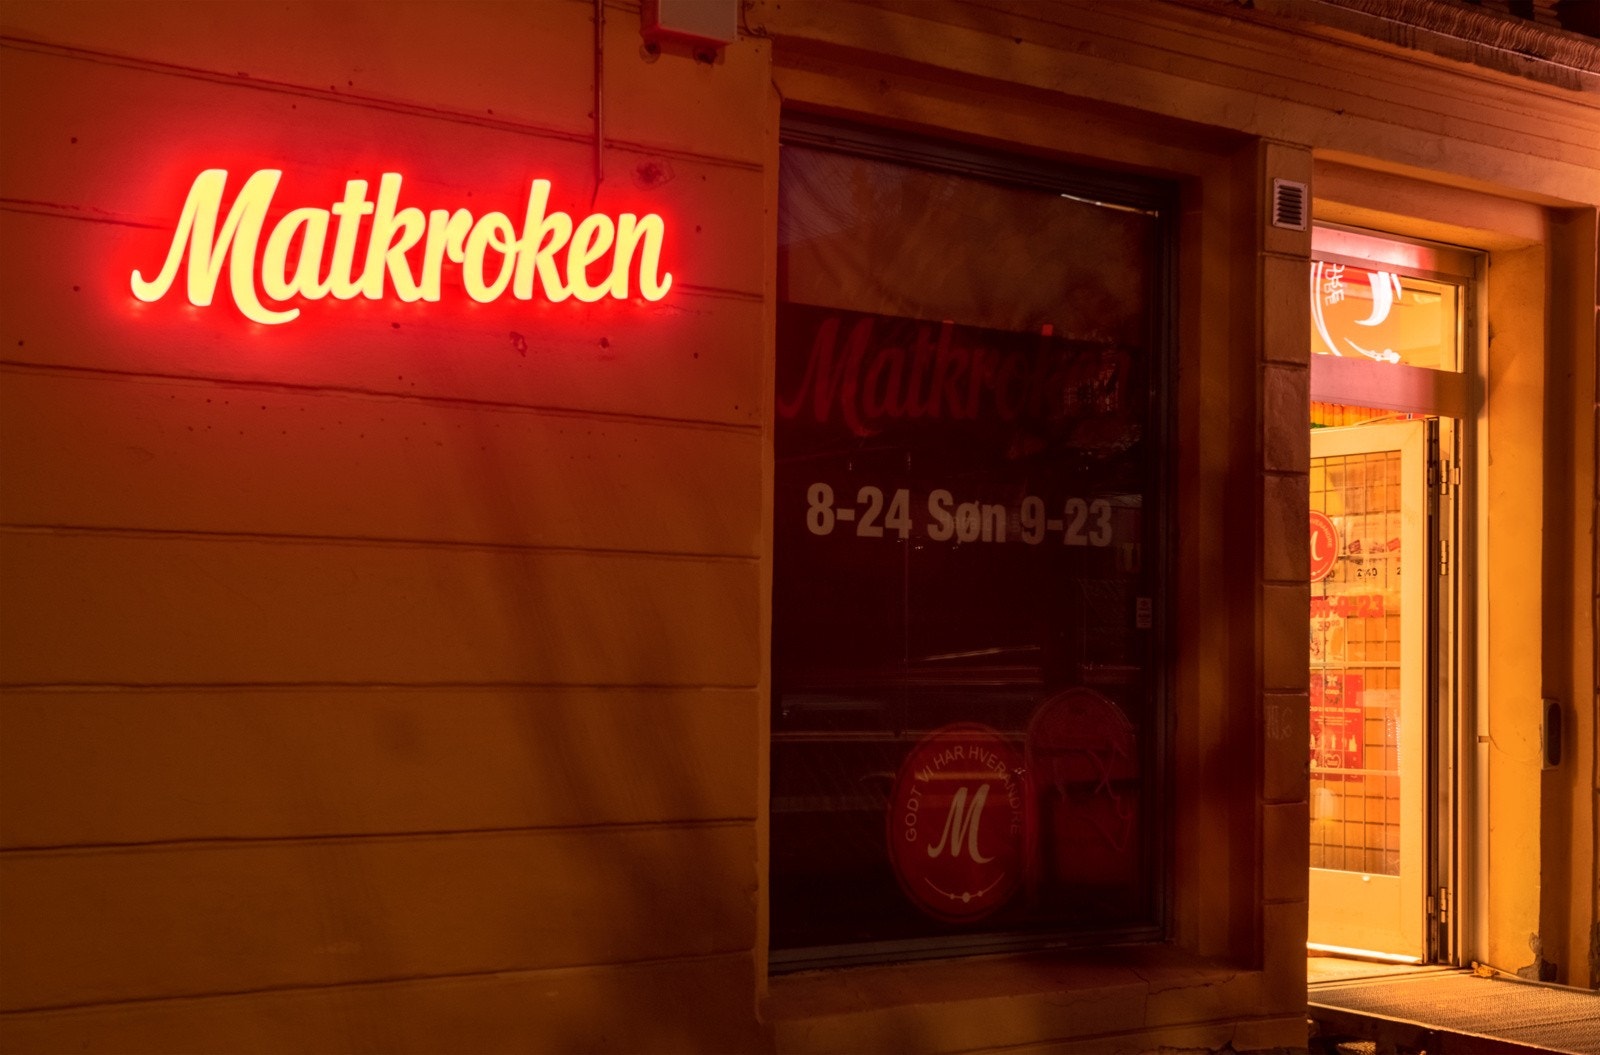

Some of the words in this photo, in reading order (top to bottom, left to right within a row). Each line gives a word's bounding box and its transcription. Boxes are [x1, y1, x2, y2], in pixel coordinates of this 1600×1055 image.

[131, 169, 672, 324] Matkroken
[806, 482, 913, 539] 8-24
[927, 488, 1007, 543] Søn
[1020, 495, 1114, 548] 9-23
[905, 784, 922, 842] GODT
[922, 765, 934, 783] VI
[933, 745, 965, 769] HAR
[927, 783, 996, 864] M
